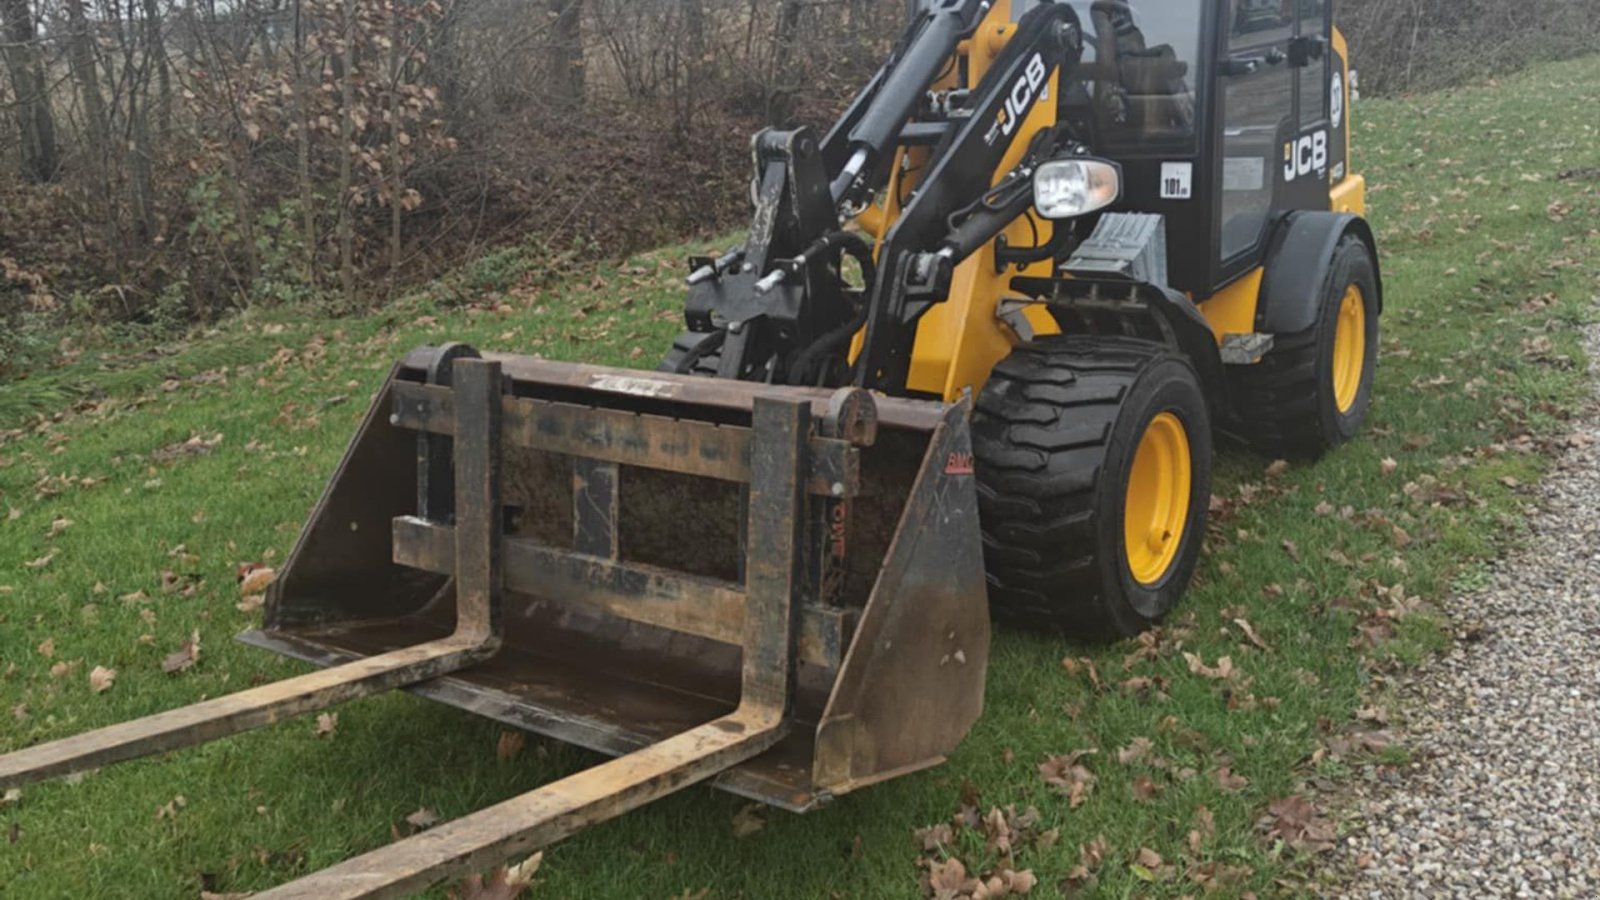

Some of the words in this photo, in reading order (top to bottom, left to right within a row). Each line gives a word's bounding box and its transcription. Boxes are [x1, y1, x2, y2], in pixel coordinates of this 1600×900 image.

[1002, 52, 1045, 136] JCB
[1284, 129, 1327, 182] JCB
[1164, 178, 1180, 196] 101
